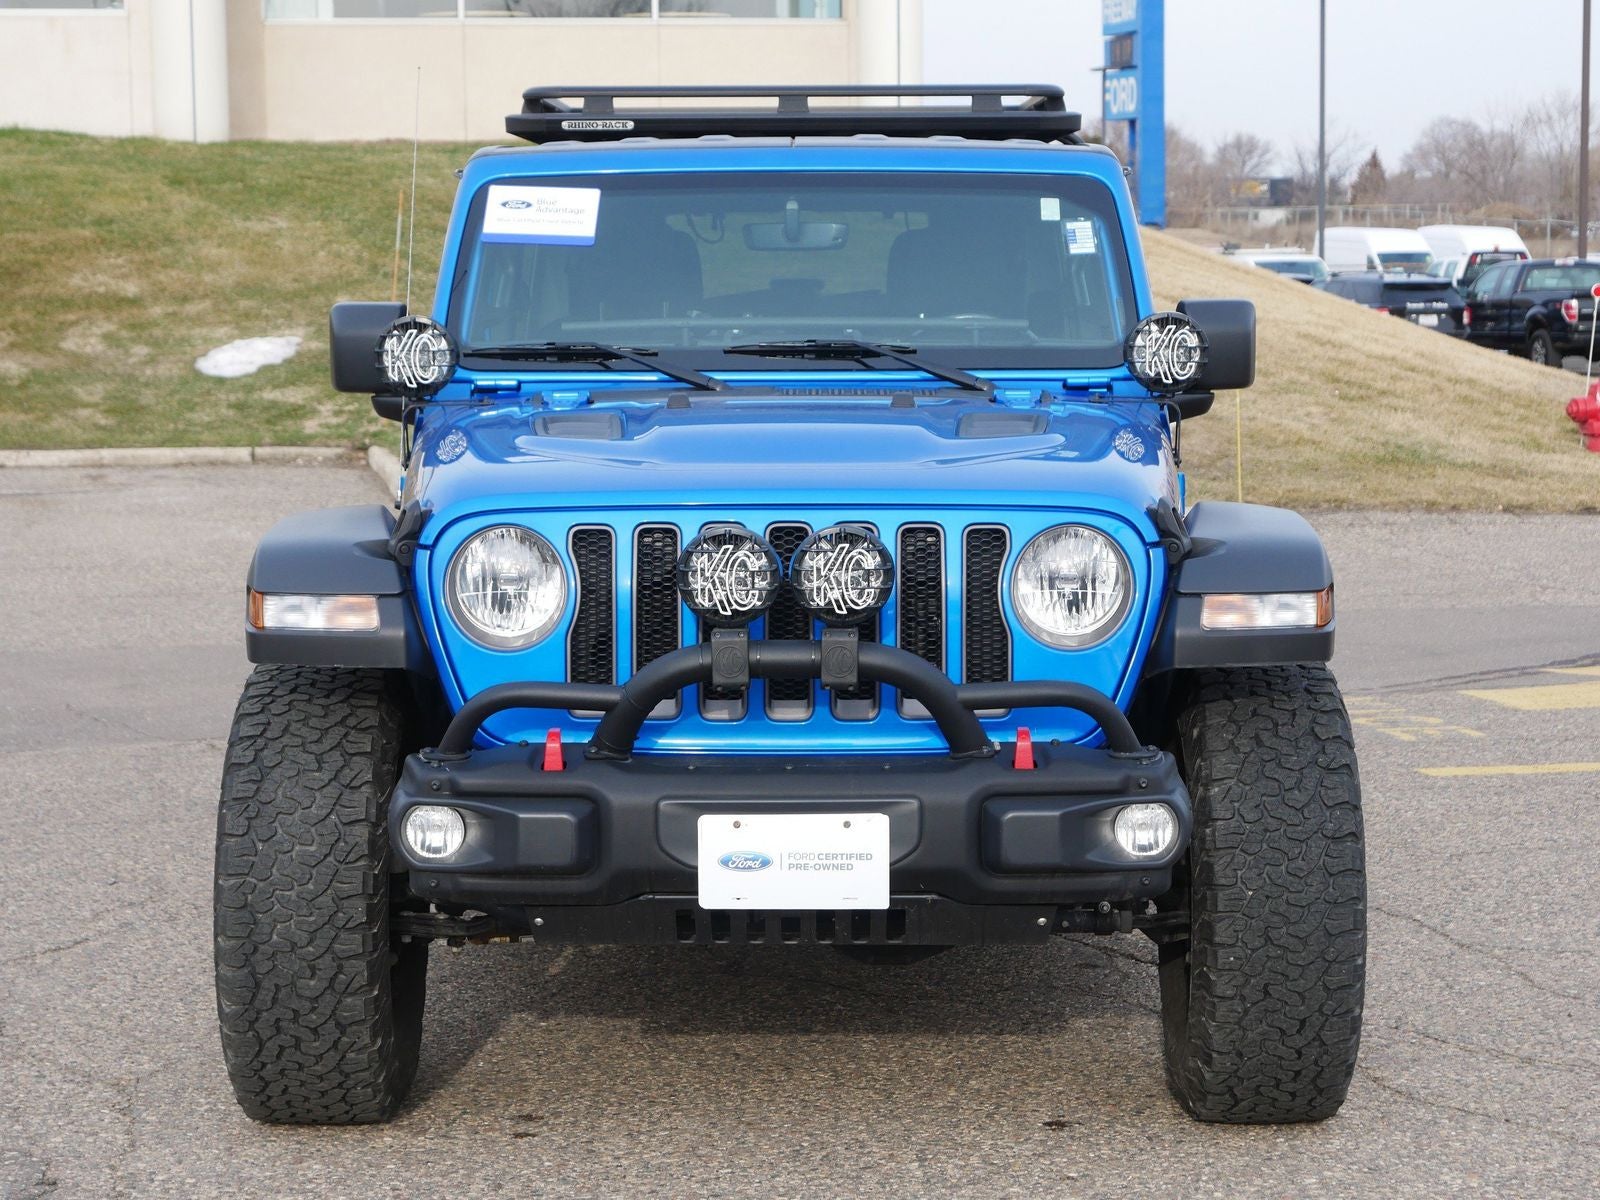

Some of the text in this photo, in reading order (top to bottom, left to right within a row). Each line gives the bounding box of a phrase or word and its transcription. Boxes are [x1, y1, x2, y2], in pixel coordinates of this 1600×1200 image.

[1104, 77, 1136, 114] FORD
[567, 121, 628, 129] RHINO-RACK
[535, 206, 585, 215] Advantage
[536, 198, 558, 206] Blue
[388, 329, 438, 388] KC
[1146, 325, 1195, 383] KC
[697, 544, 759, 615] KC
[813, 543, 874, 614] KC
[788, 852, 873, 861] FORD CERTIFIED
[788, 863, 854, 871] PRE-OWNED
